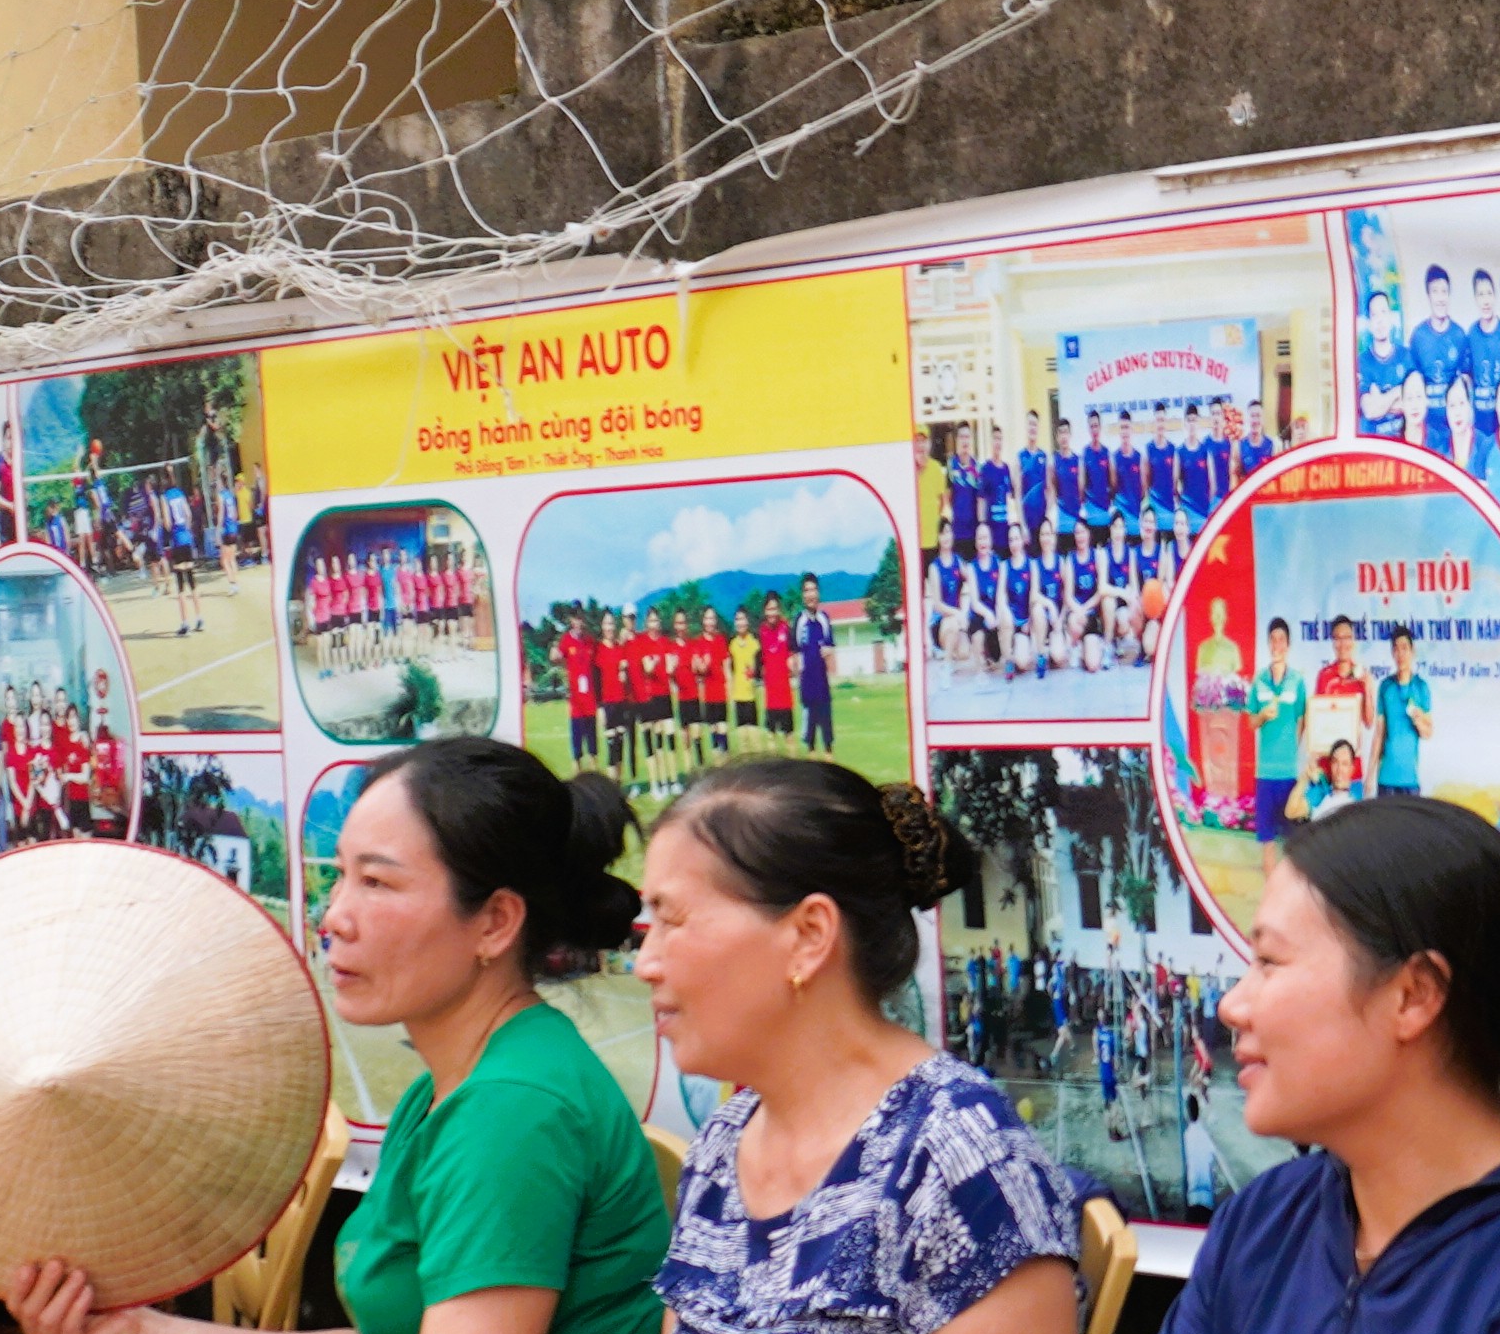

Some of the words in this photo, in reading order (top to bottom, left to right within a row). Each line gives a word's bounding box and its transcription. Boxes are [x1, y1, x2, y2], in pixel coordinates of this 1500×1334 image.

[442, 334, 504, 403] VIỆT
[519, 337, 564, 384] AN
[578, 325, 670, 377] AUTO
[418, 416, 471, 454] Đồng
[479, 418, 532, 446] hành
[540, 412, 592, 443] cùng
[600, 405, 635, 440] đội
[644, 400, 703, 432] bóng
[1417, 551, 1470, 605] HỘI
